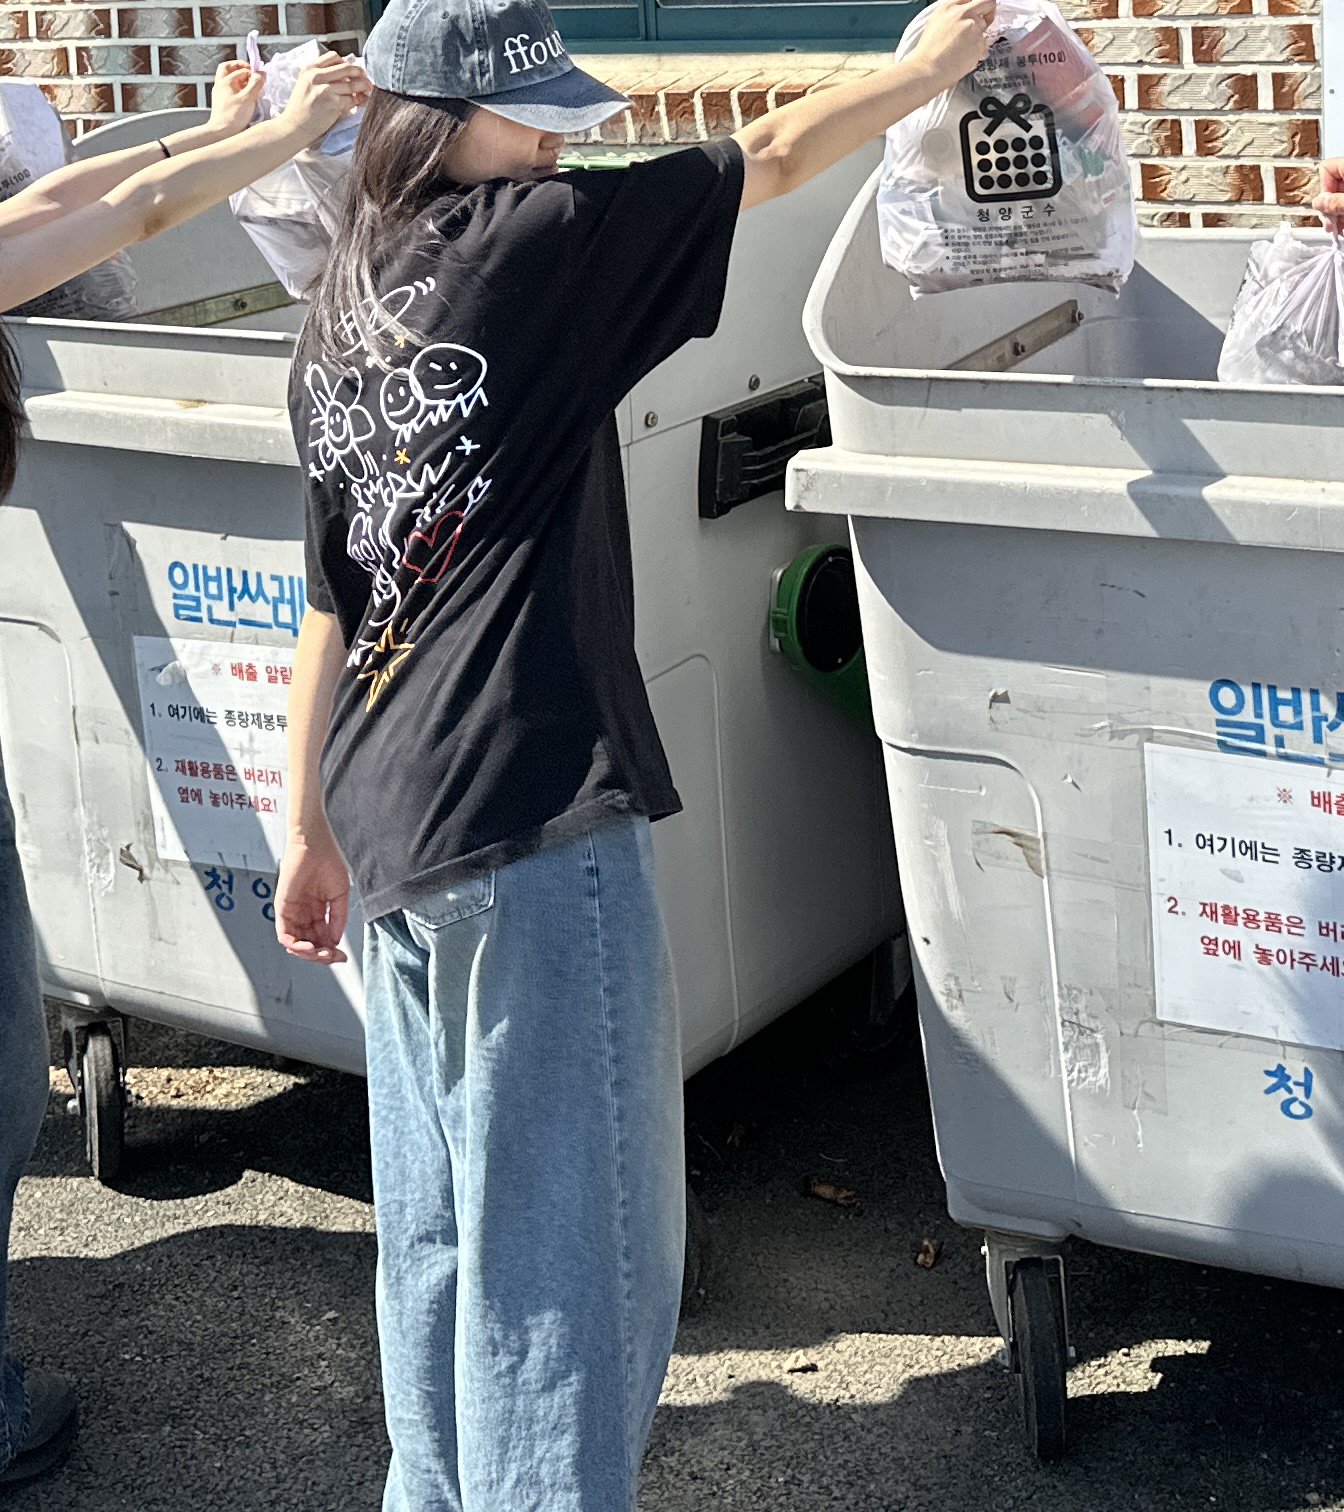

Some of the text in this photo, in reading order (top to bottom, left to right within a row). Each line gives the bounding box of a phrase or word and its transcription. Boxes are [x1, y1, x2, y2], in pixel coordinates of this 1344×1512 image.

[230, 662, 258, 682] 배출
[167, 703, 218, 725] 여기에는
[174, 759, 238, 782] 재활용품은
[244, 767, 282, 788] 버리지
[177, 786, 203, 806] 옆에
[1164, 828, 1183, 848] 1.
[1195, 832, 1281, 865] 여기에는
[1166, 896, 1187, 916] 2.
[1199, 900, 1306, 937] 재활용품은
[1200, 935, 1243, 962] 옆에
